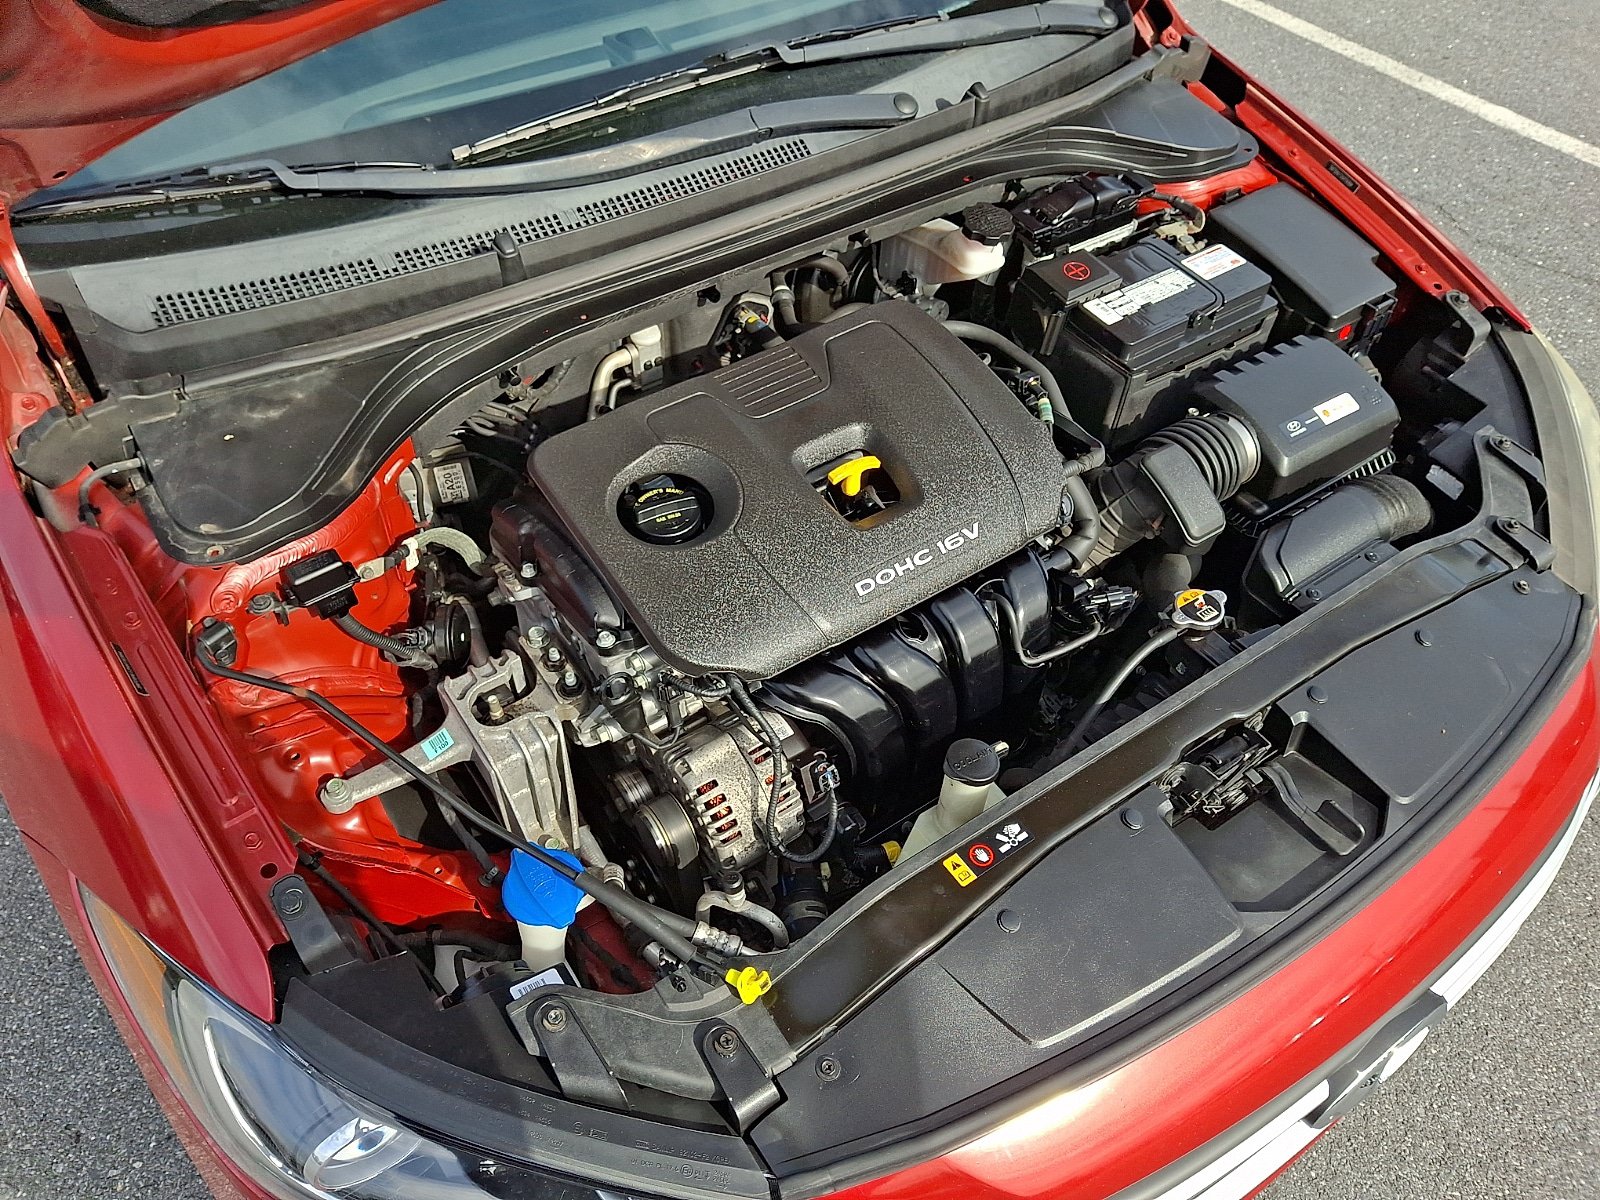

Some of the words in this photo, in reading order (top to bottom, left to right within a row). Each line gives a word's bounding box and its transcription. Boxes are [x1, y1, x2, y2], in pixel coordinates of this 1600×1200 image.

[443, 472, 456, 491] A20
[854, 548, 933, 597] DOHC
[936, 521, 979, 555] 16V
